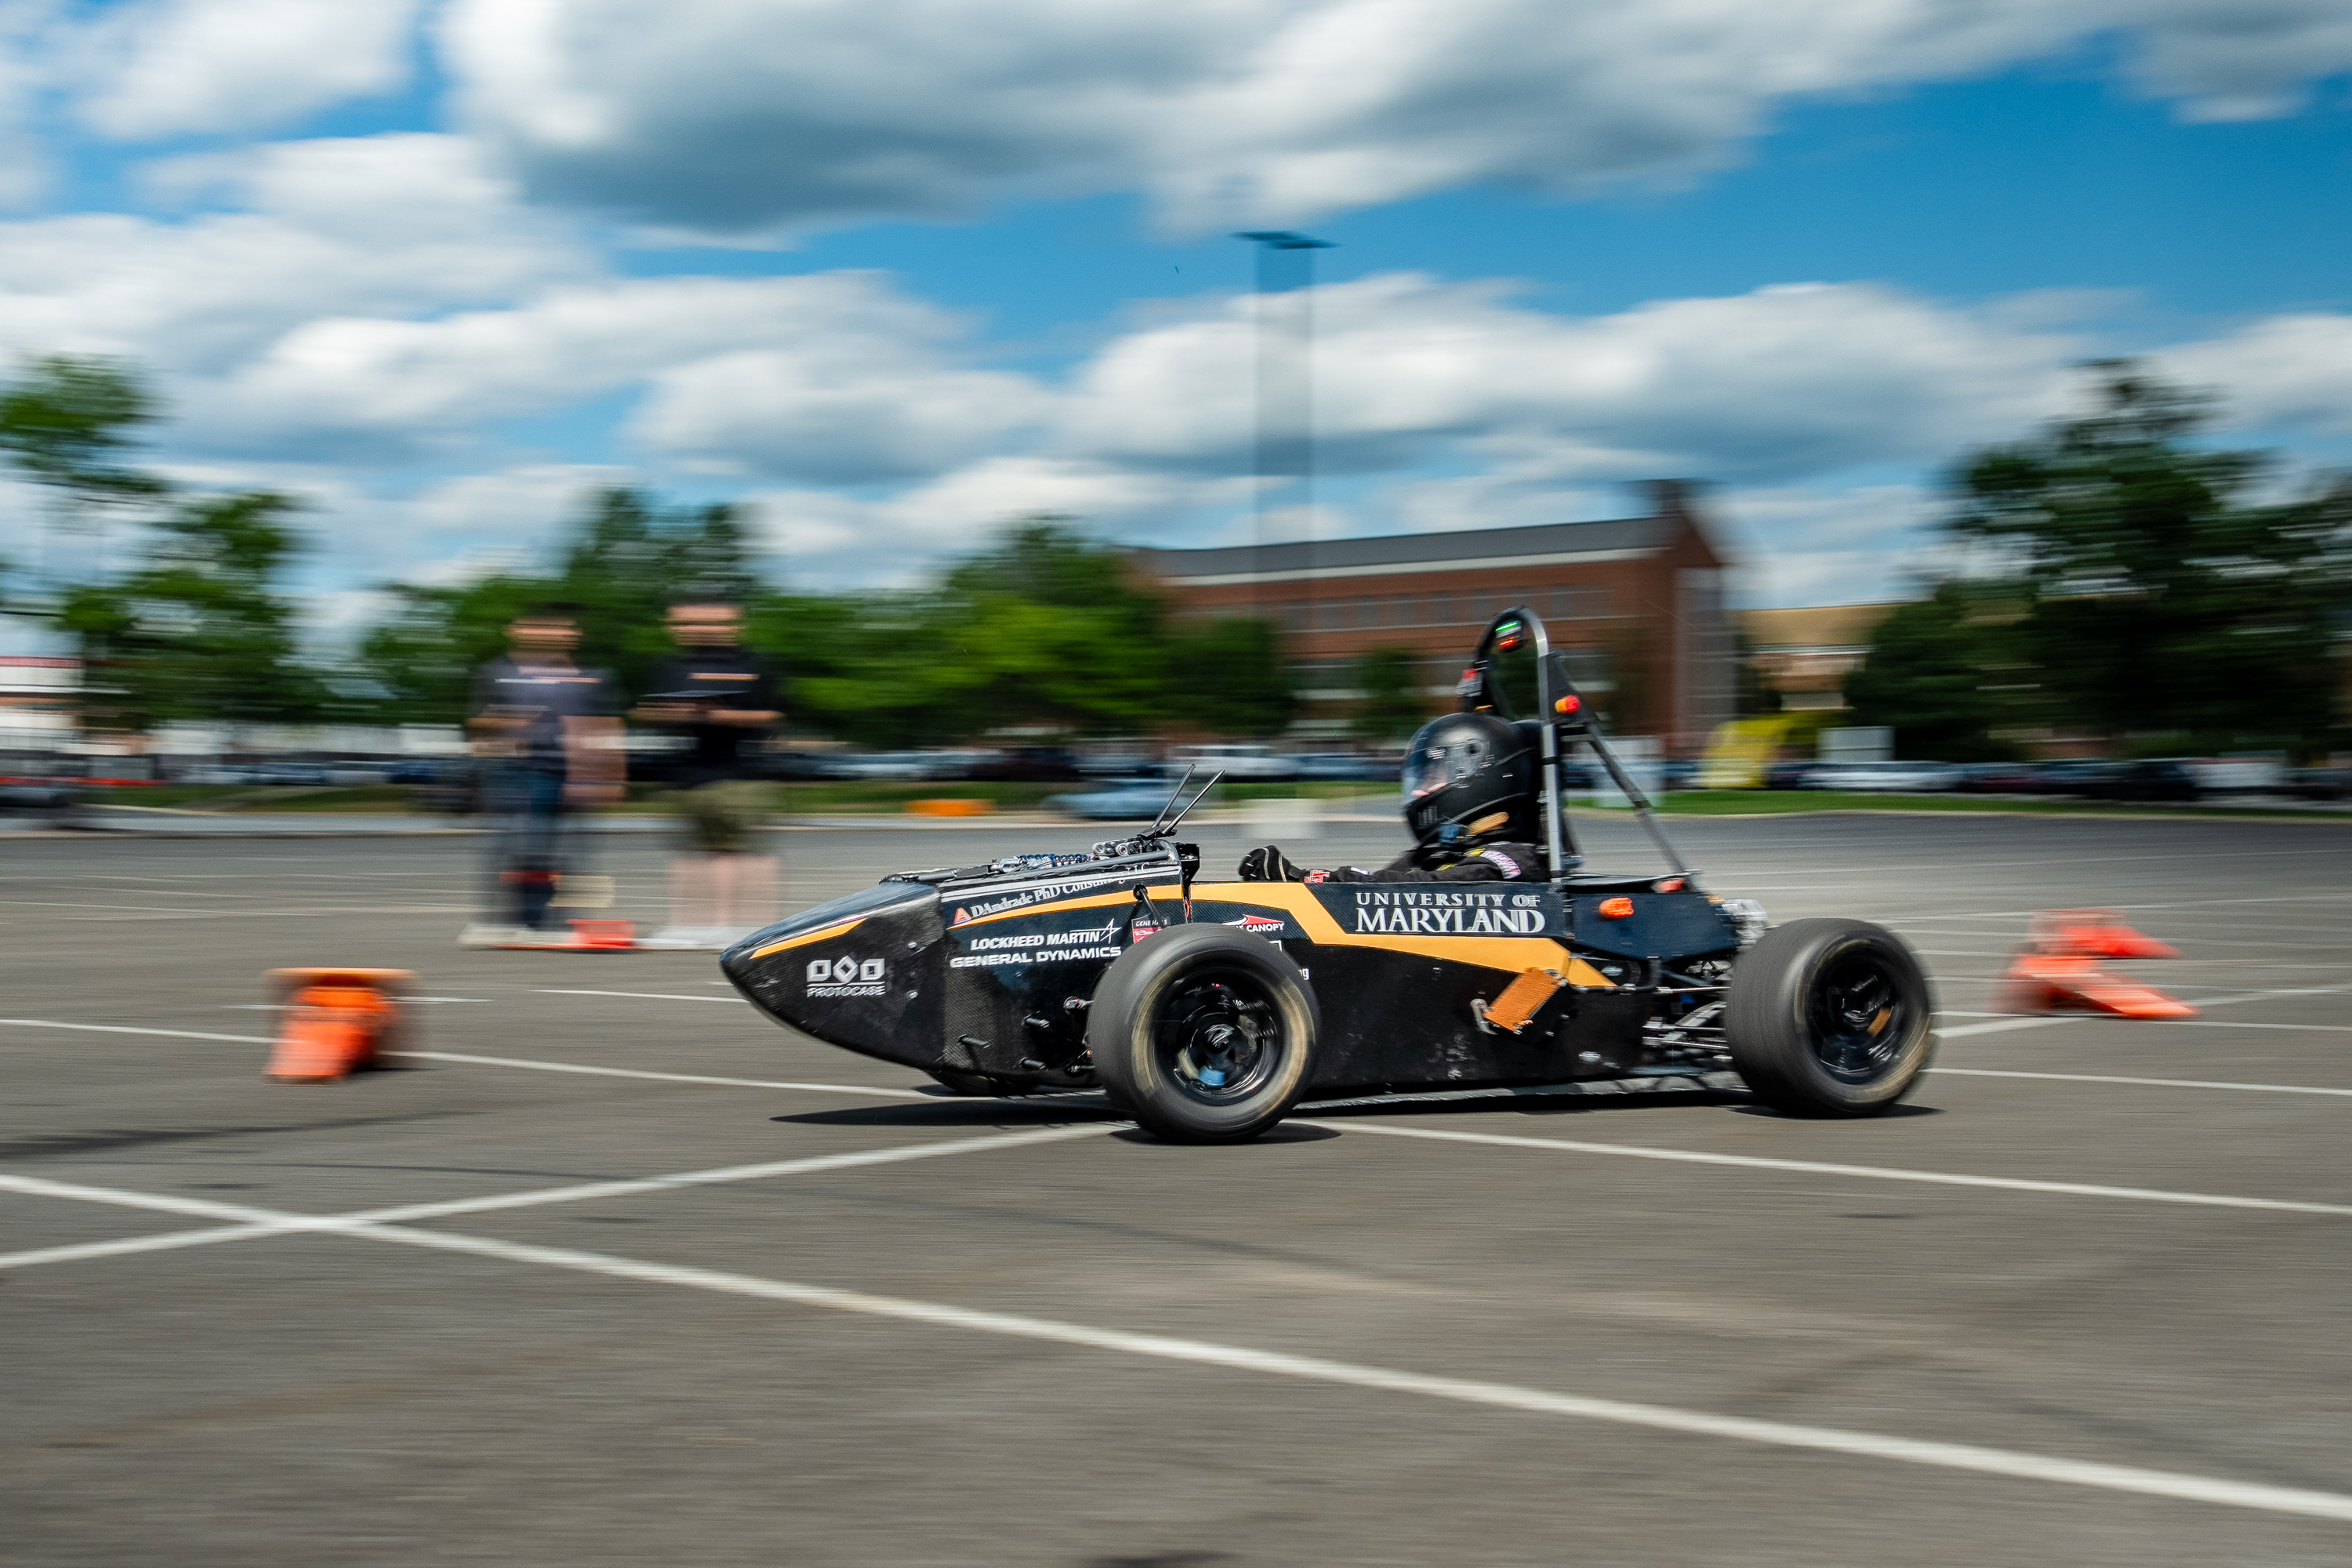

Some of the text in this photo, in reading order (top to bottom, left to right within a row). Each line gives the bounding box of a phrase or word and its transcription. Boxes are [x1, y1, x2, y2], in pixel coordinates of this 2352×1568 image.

[1033, 886, 1062, 902] PhD
[1356, 892, 1541, 908] UNIVERSITY OF
[1246, 923, 1285, 933] CANOPY
[1355, 907, 1546, 934] MARYLAND
[971, 931, 1101, 951] LOCKHEED MARTIN
[949, 946, 1122, 968] GENERAL DYNAMICS
[807, 985, 887, 998] PROTOCASE
